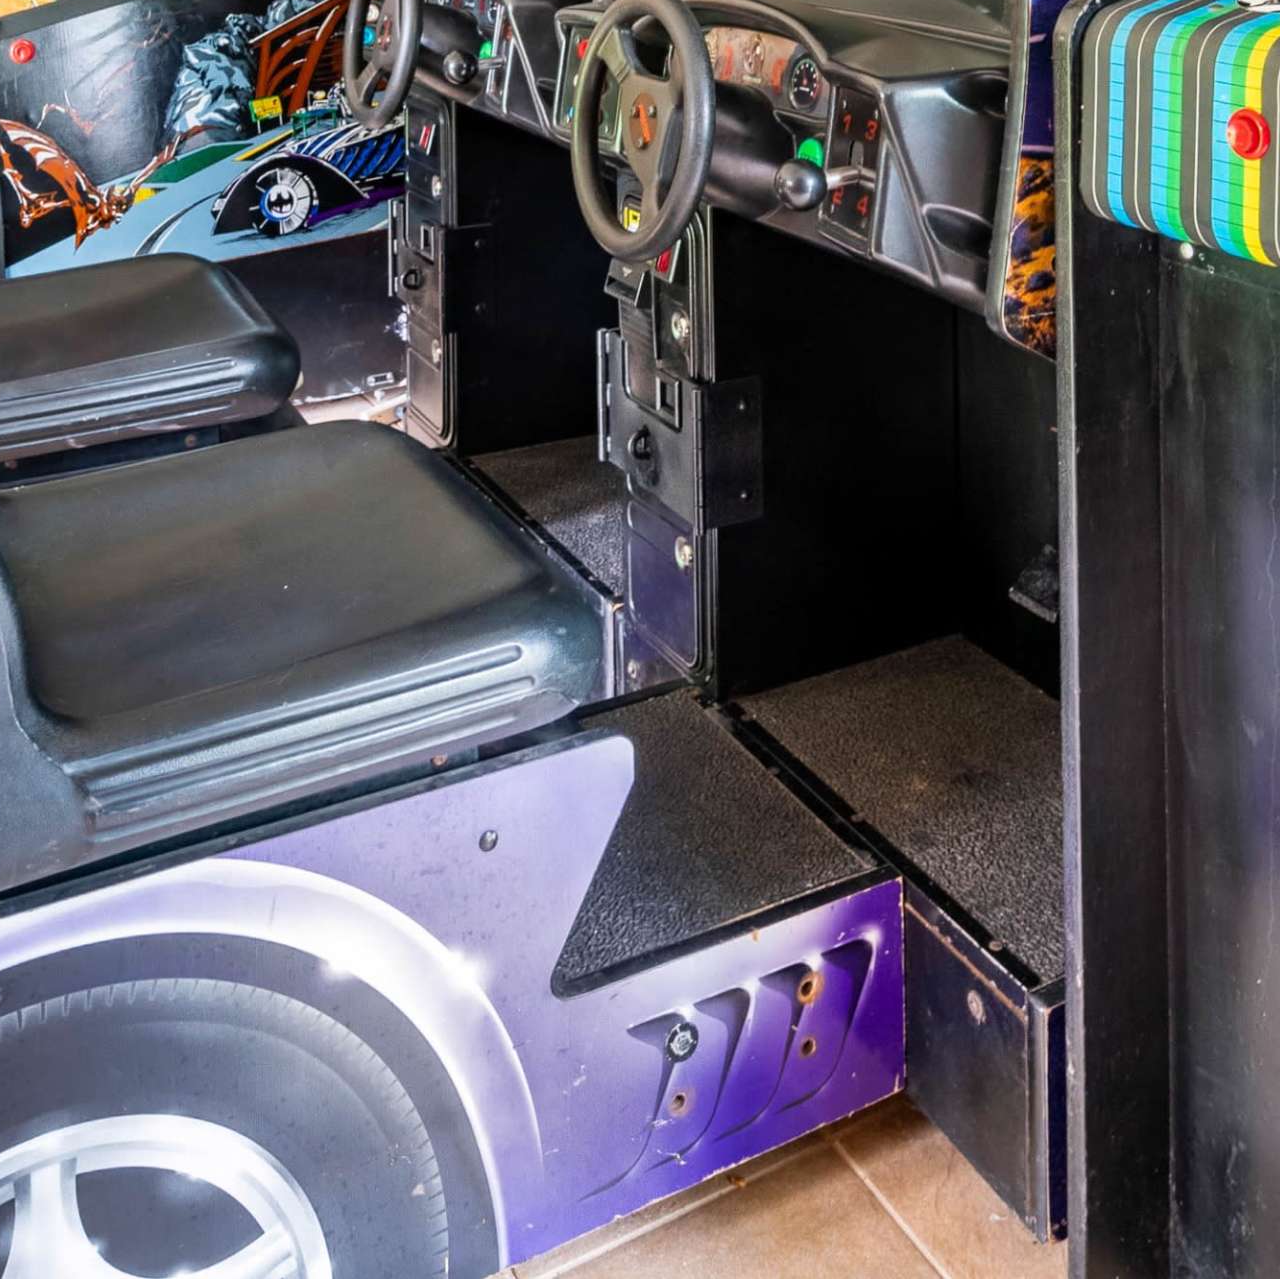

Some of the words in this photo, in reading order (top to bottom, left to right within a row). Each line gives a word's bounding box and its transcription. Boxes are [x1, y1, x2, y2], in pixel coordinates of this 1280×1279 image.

[842, 114, 853, 132] 1
[864, 120, 878, 140] 3
[856, 197, 869, 217] 4
